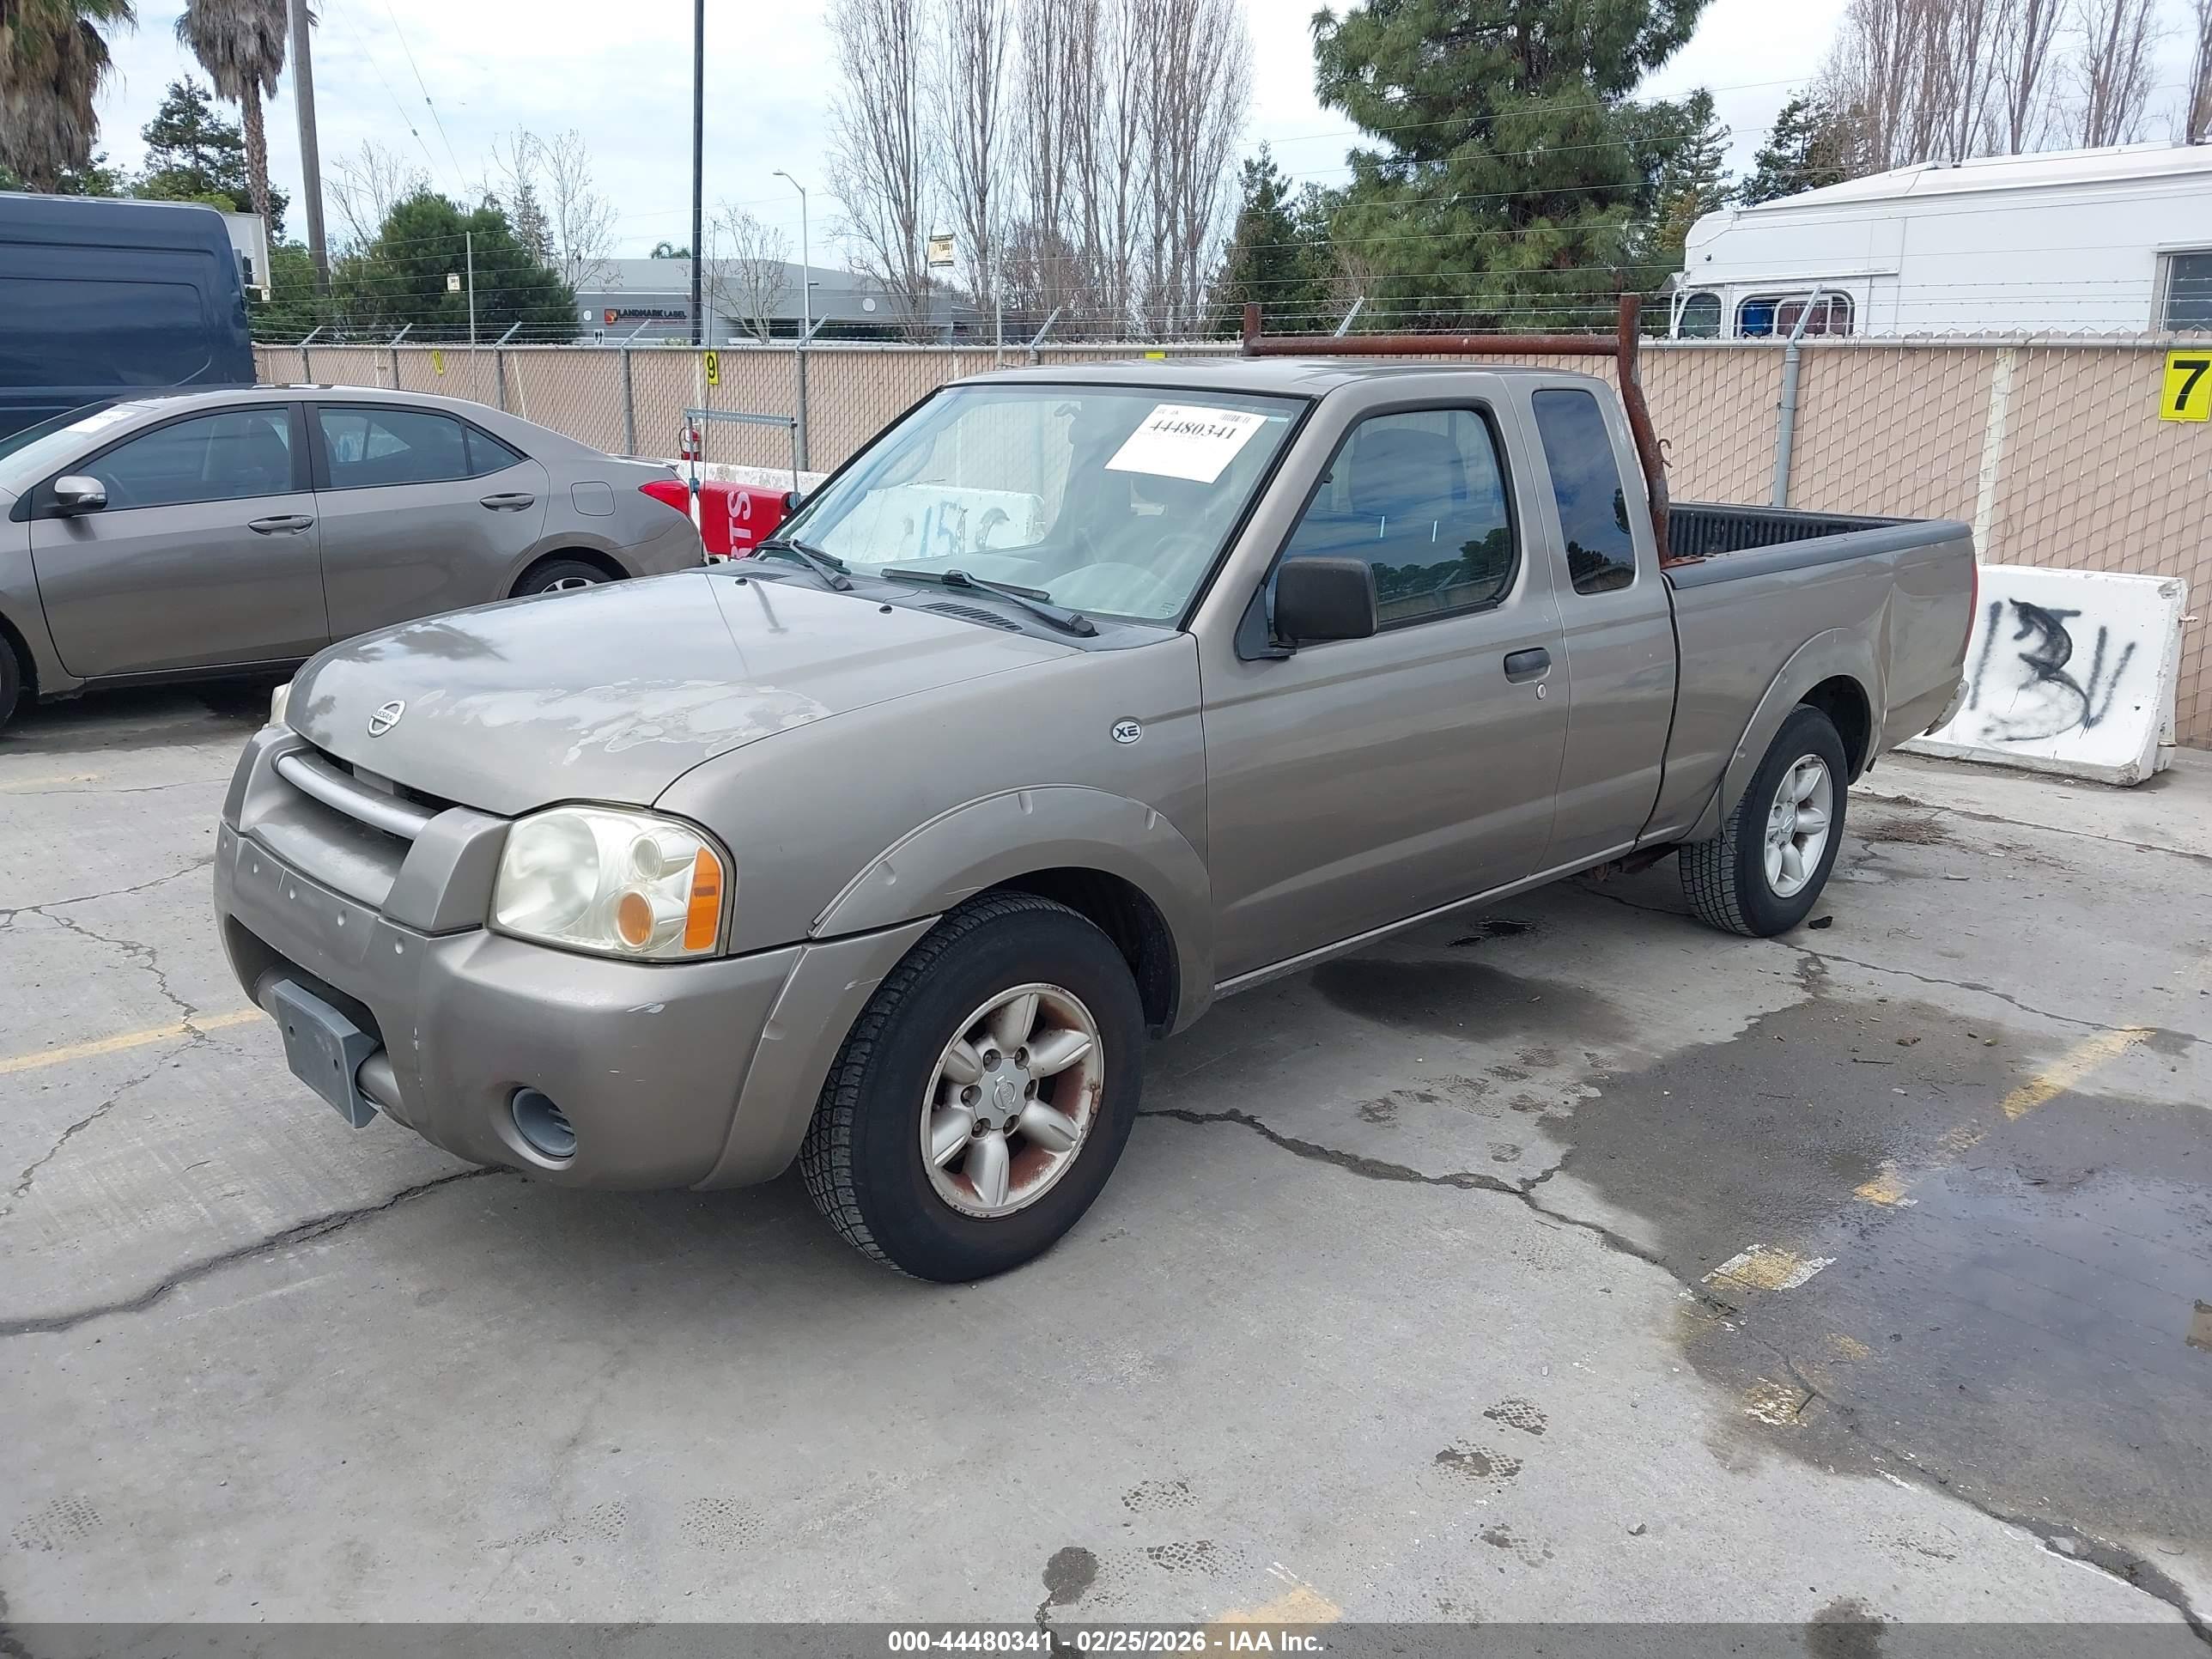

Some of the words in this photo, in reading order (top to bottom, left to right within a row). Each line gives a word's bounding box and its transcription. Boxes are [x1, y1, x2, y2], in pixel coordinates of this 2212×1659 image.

[707, 355, 715, 379] 9
[2173, 360, 2211, 410] 7
[1149, 419, 1237, 439] 44480341
[1115, 725, 1139, 738] XE
